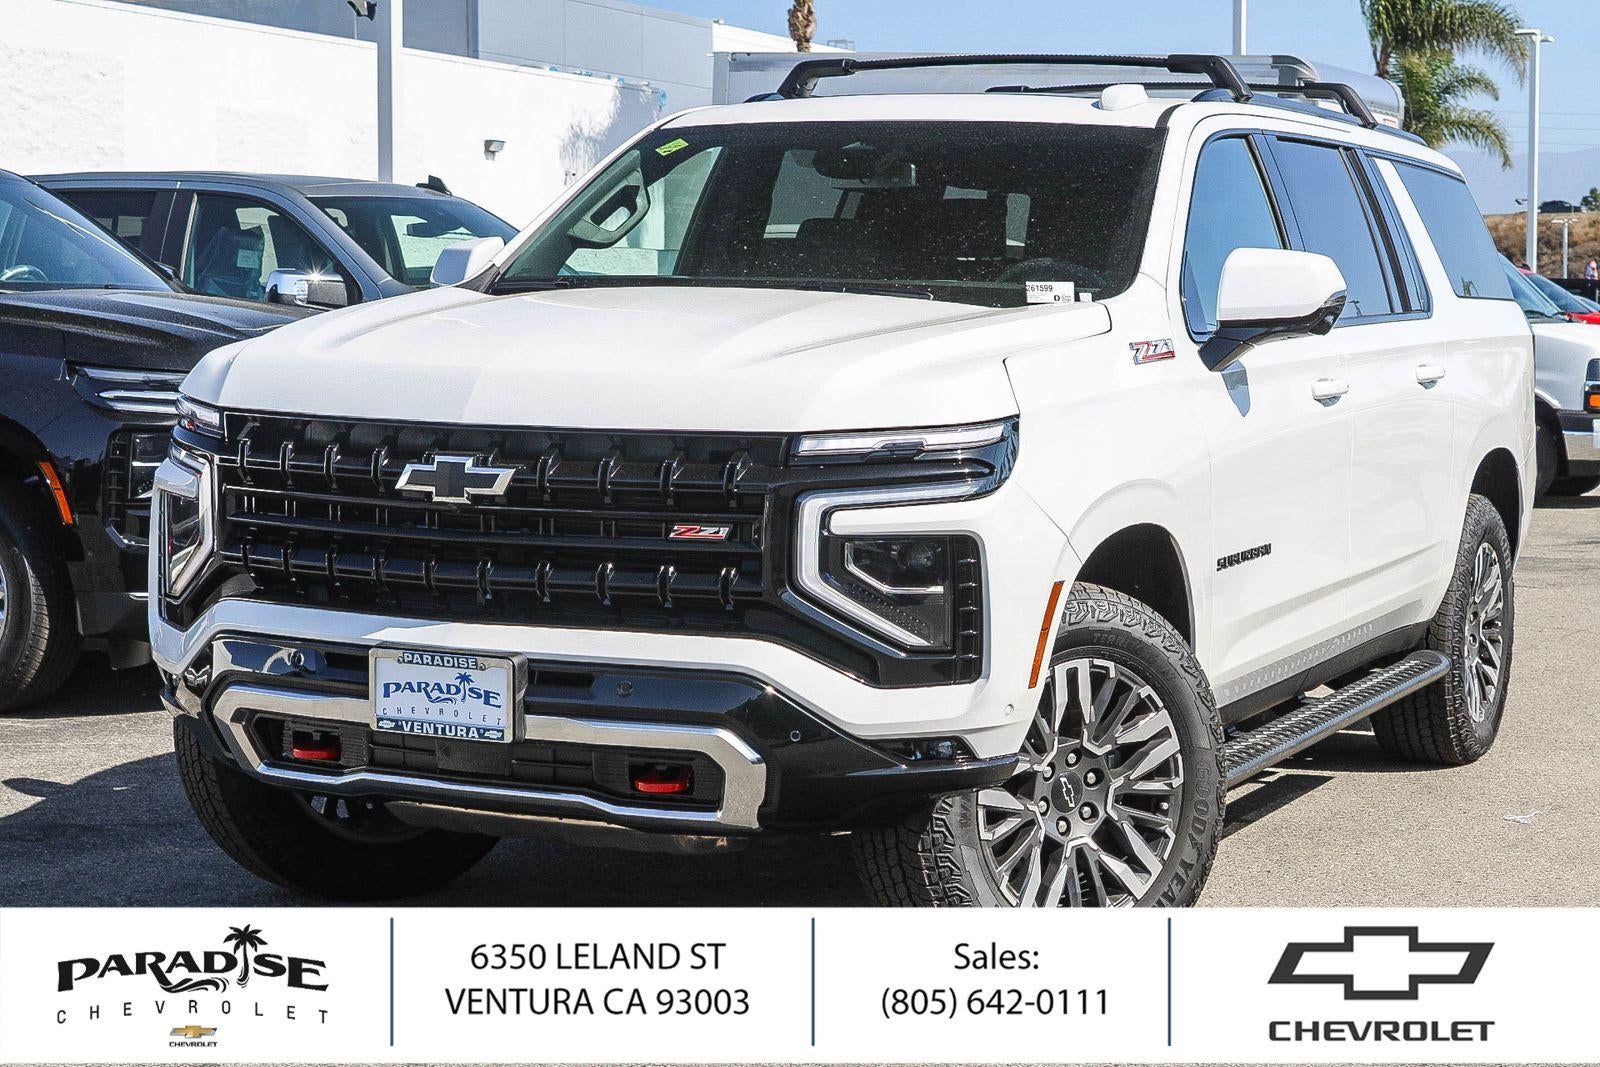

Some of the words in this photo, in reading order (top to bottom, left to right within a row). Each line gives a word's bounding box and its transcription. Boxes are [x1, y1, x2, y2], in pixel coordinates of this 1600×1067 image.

[1129, 338, 1175, 365] Z71
[669, 525, 730, 540] Z71
[1216, 543, 1271, 572] SUBURBAN
[403, 653, 478, 669] PARADISE
[382, 681, 502, 708] PARADISE
[382, 706, 502, 725] CHEVROLET
[402, 720, 480, 739] VENTURA
